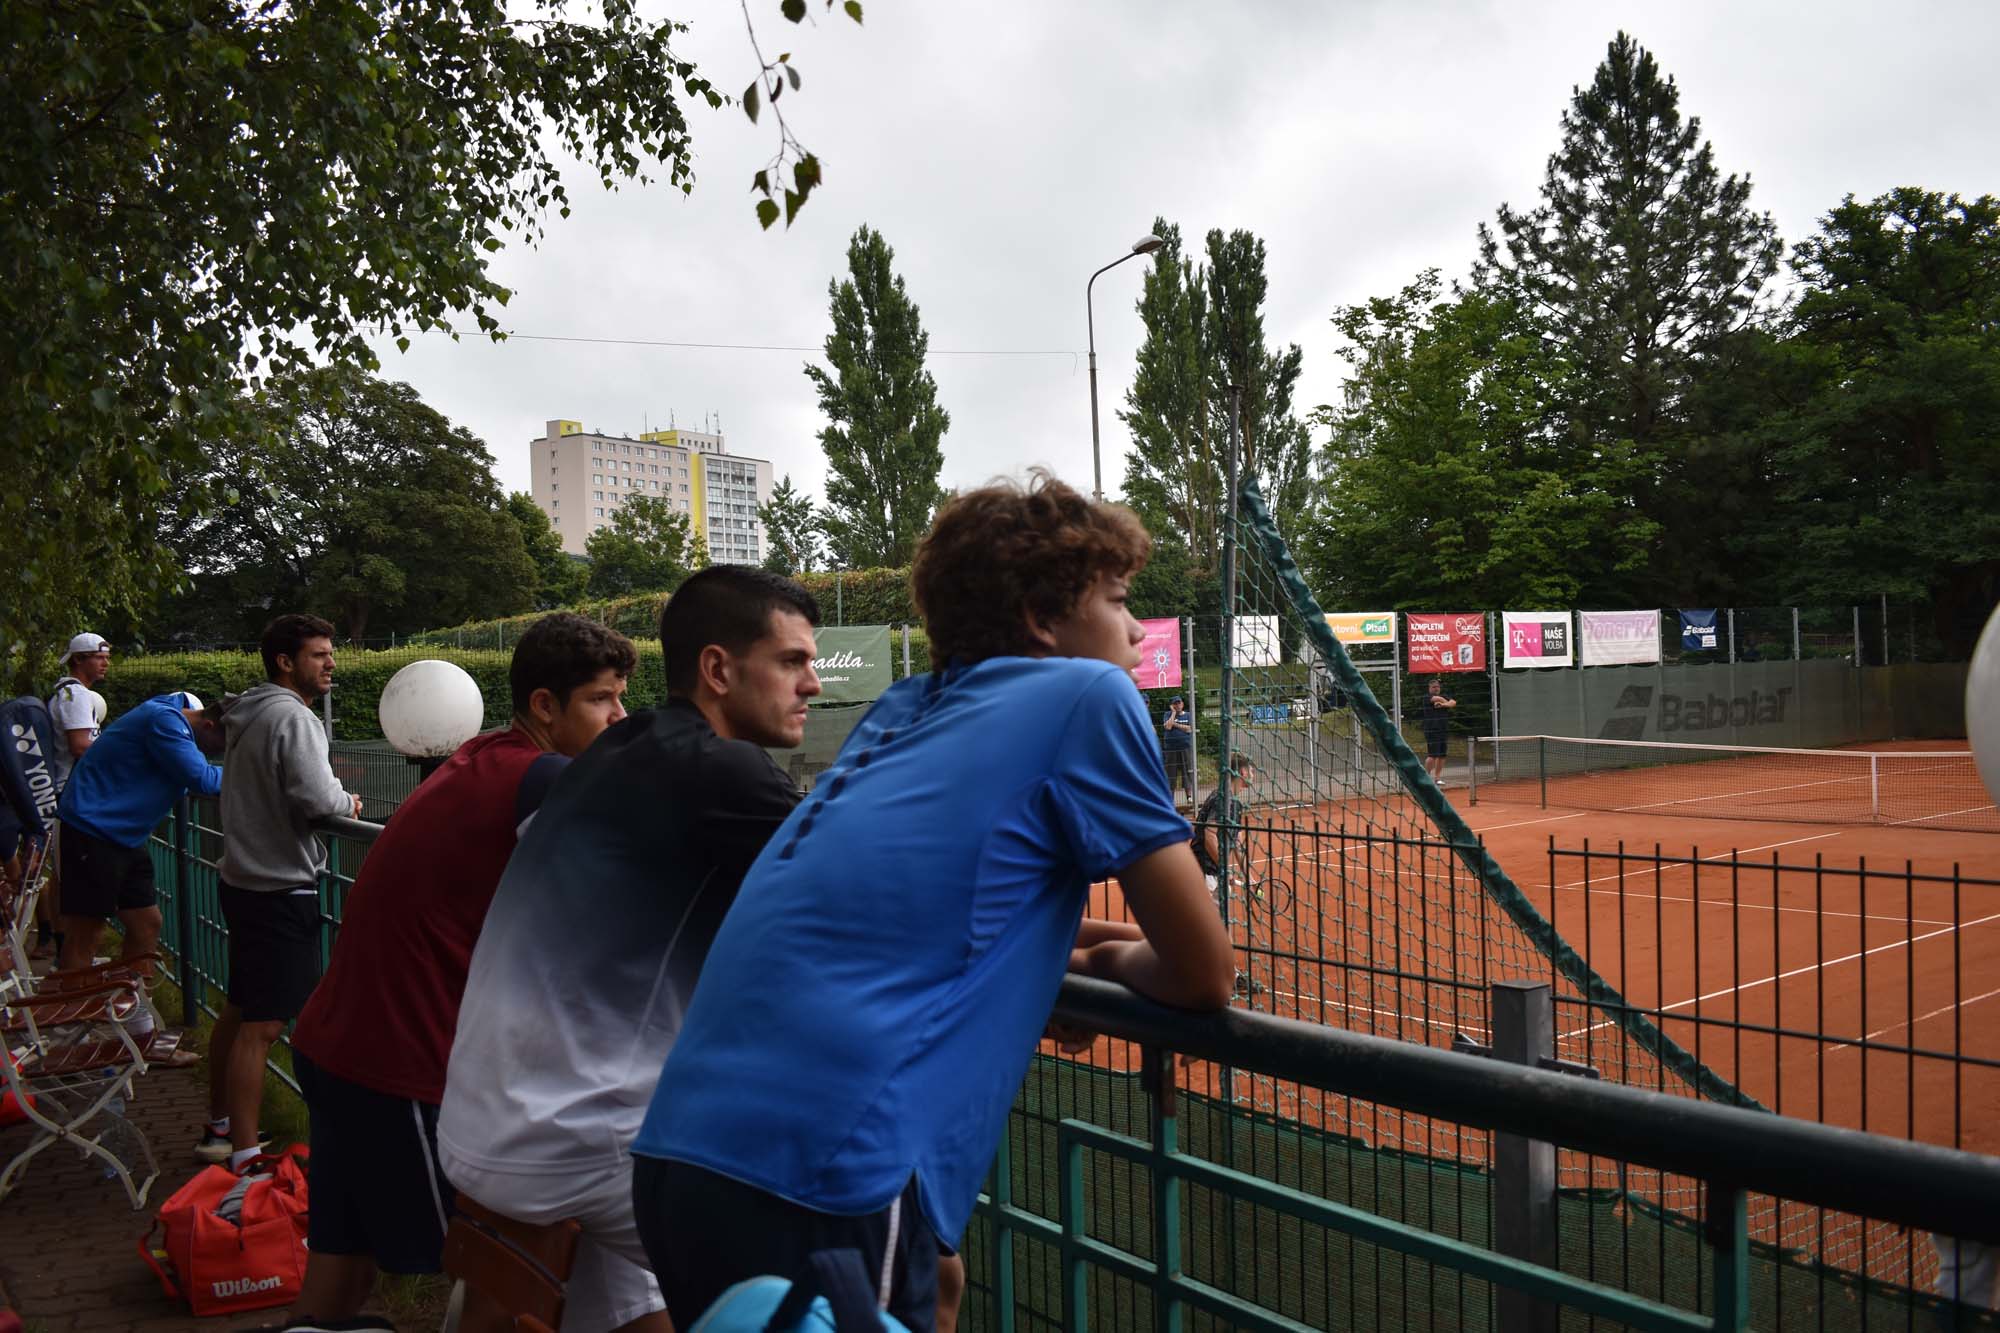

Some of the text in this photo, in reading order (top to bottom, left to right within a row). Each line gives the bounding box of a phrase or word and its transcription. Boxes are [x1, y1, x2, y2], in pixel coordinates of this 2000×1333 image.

[1366, 622, 1388, 633] Plzeň
[1410, 621, 1444, 631] KOMPLETNÍ
[1544, 627, 1564, 640] NAŠE
[1544, 640, 1564, 651] VOLBA
[212, 1275, 284, 1298] Wilson
